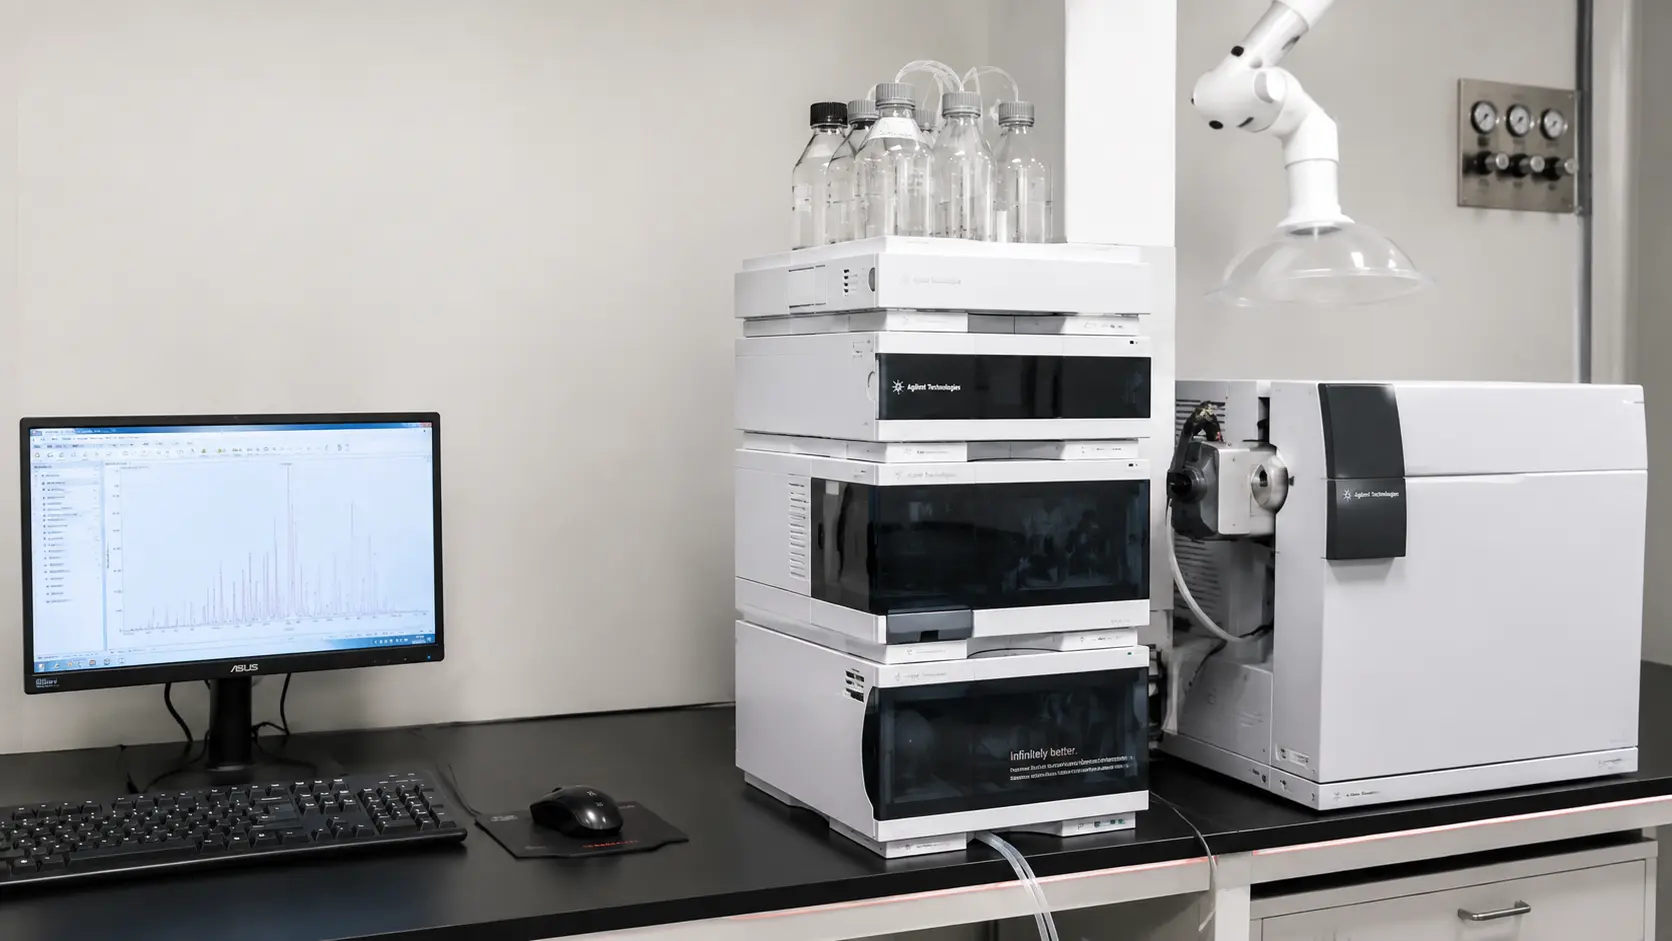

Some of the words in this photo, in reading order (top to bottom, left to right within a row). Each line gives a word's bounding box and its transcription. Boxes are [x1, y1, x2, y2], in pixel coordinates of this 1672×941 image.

[907, 383, 926, 392] Agilent
[927, 383, 961, 392] Technologies
[230, 664, 259, 672] ASUS
[1010, 748, 1048, 760] Infinitely
[1050, 747, 1078, 757] better.
